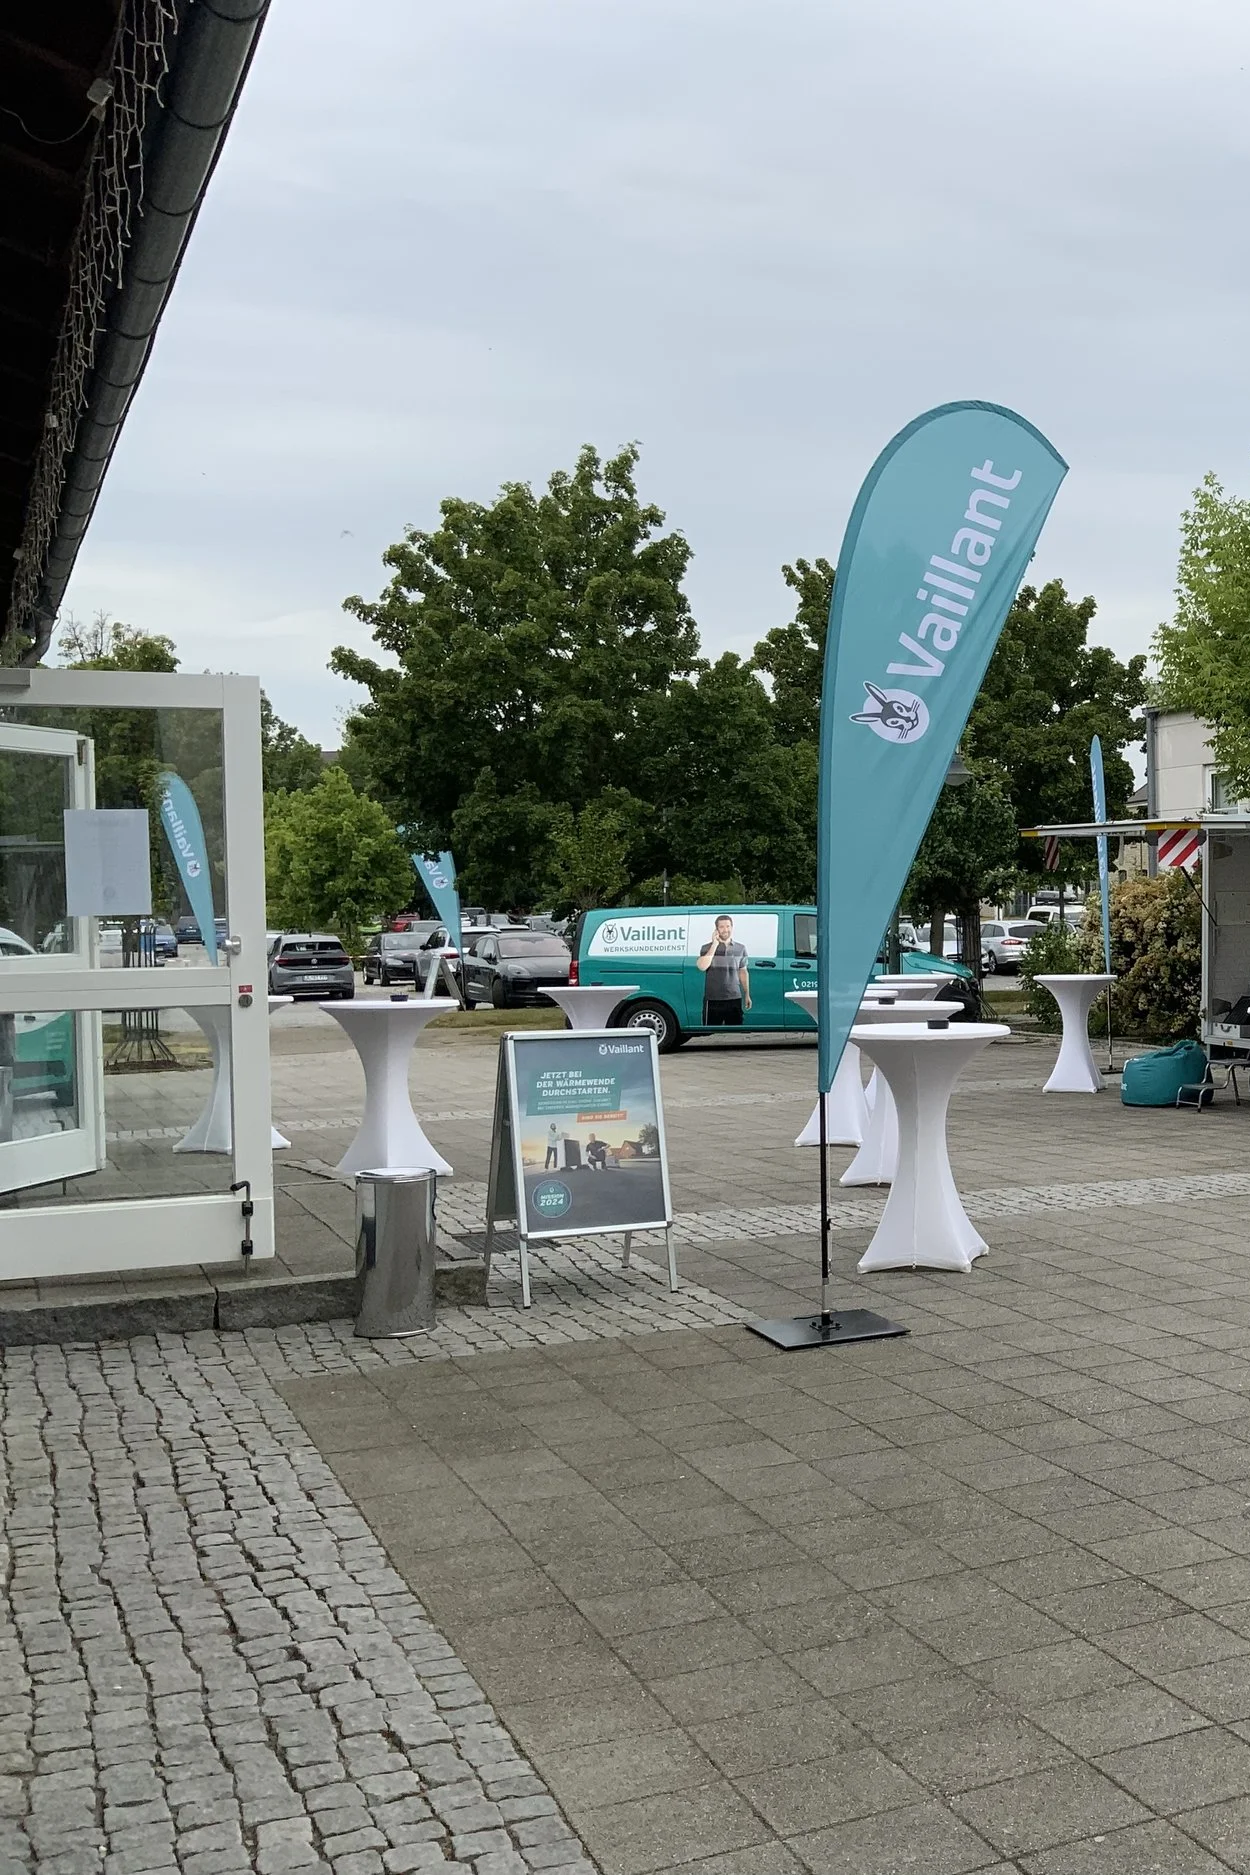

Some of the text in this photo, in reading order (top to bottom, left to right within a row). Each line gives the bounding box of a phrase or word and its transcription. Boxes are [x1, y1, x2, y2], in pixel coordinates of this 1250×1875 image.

[886, 459, 1023, 677] Vaillant
[620, 926, 686, 941] Vaillant
[603, 945, 686, 953] WERKSKUNDENDIENST
[608, 1044, 645, 1054] Vaillant
[540, 1071, 567, 1079] JETZT
[556, 1077, 616, 1087] WÄRMEWENDE
[542, 1086, 611, 1097] DURCHSTARTEN.
